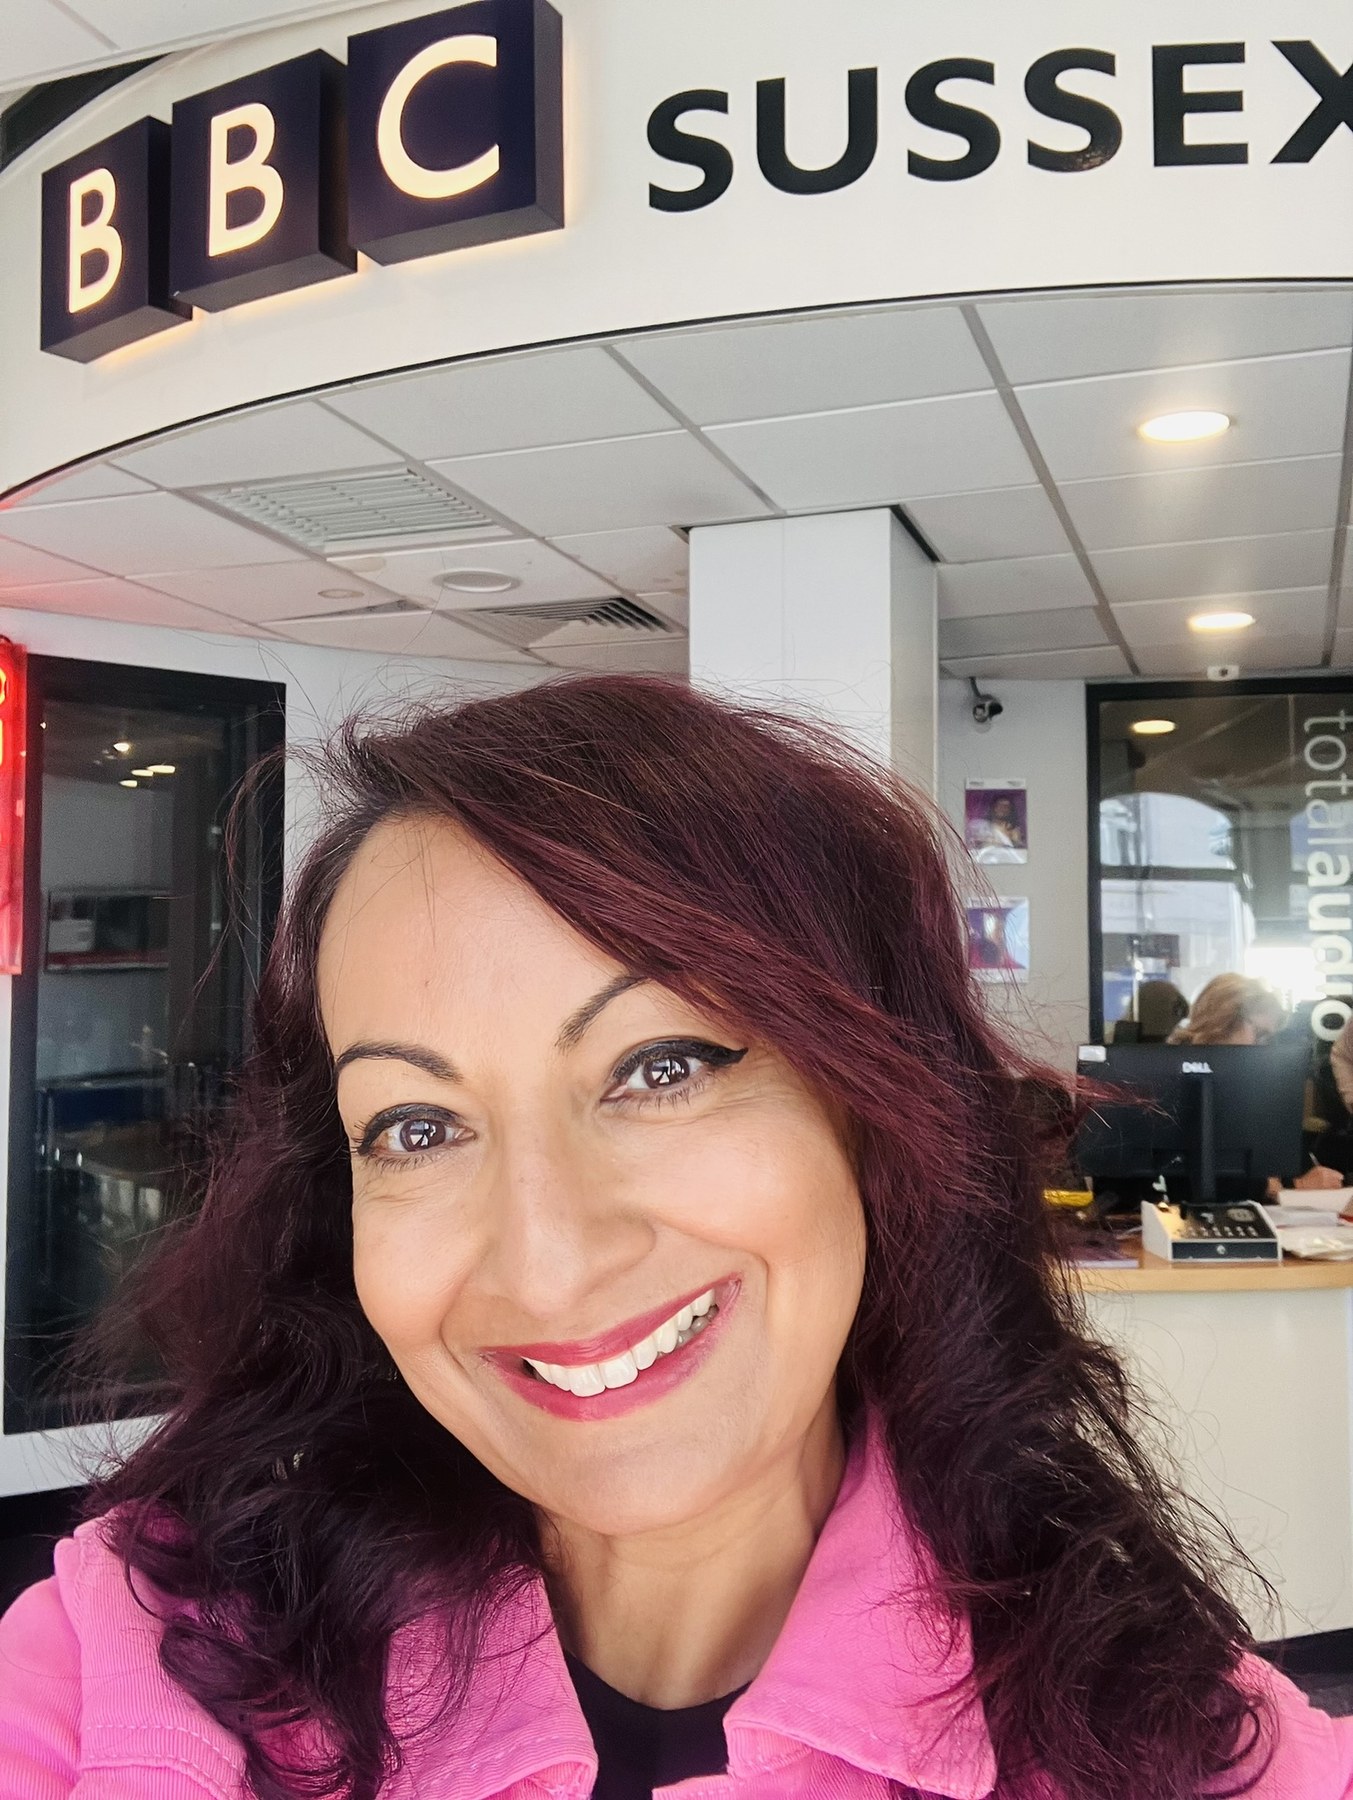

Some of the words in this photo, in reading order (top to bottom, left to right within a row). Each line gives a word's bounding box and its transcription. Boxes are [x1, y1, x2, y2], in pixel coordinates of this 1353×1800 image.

[68, 34, 500, 314] BBC
[646, 39, 1353, 213] SUSSEX
[1182, 1061, 1214, 1074] DELL
